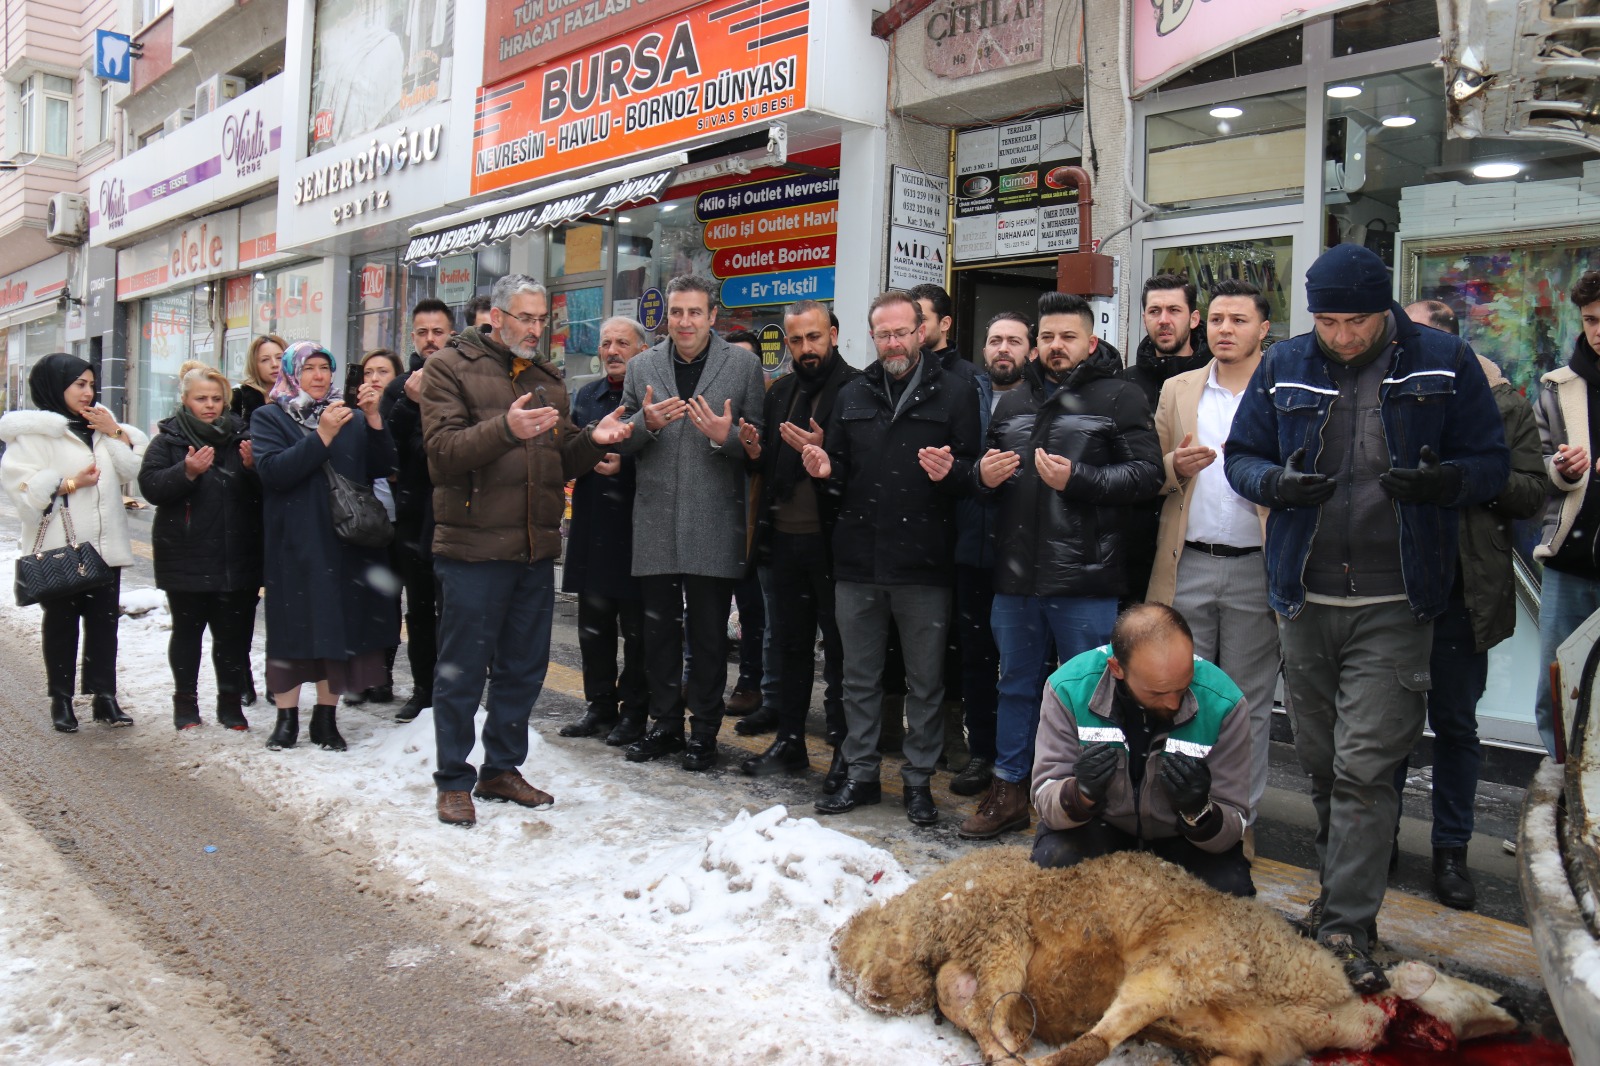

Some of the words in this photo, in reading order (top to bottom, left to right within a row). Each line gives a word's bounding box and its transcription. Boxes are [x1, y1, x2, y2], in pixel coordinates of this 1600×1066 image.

[513, 2, 544, 28] TÜM
[1014, 43, 1035, 56] 1991
[540, 20, 702, 124] BURSA
[476, 131, 545, 176] NEVRESİM
[558, 109, 611, 153] HAVLU
[626, 85, 699, 133] BORNOZ
[703, 56, 797, 113] DÜNYASI
[697, 113, 736, 130] SİVAS
[742, 97, 795, 121] ŞUBESİ
[236, 160, 262, 178] PERDE
[294, 124, 443, 206] SEMERCİOĞLU
[1010, 156, 1027, 165] ODASI
[1001, 173, 1036, 187] farmak
[743, 186, 782, 204] Outlet
[330, 190, 391, 225] ÇEYİZ
[404, 238, 438, 261] BURSA
[437, 218, 491, 254] NEVRESİM
[490, 212, 535, 240] HAVLU
[534, 192, 596, 228] BORNOZ
[597, 171, 671, 208] DÜNYASI
[757, 216, 800, 234] Outlet
[997, 230, 1022, 241] BURHAN
[1022, 228, 1036, 238] AVCI
[171, 223, 223, 278] elele
[731, 252, 774, 269] Outlet
[778, 246, 830, 264] Bornoz
[894, 239, 944, 264] MİRA
[893, 256, 915, 267] HARİTA
[923, 261, 944, 272] İNŞAAT
[750, 282, 768, 298] Ev
[771, 277, 817, 296] Tekstil
[259, 281, 323, 322] elele
